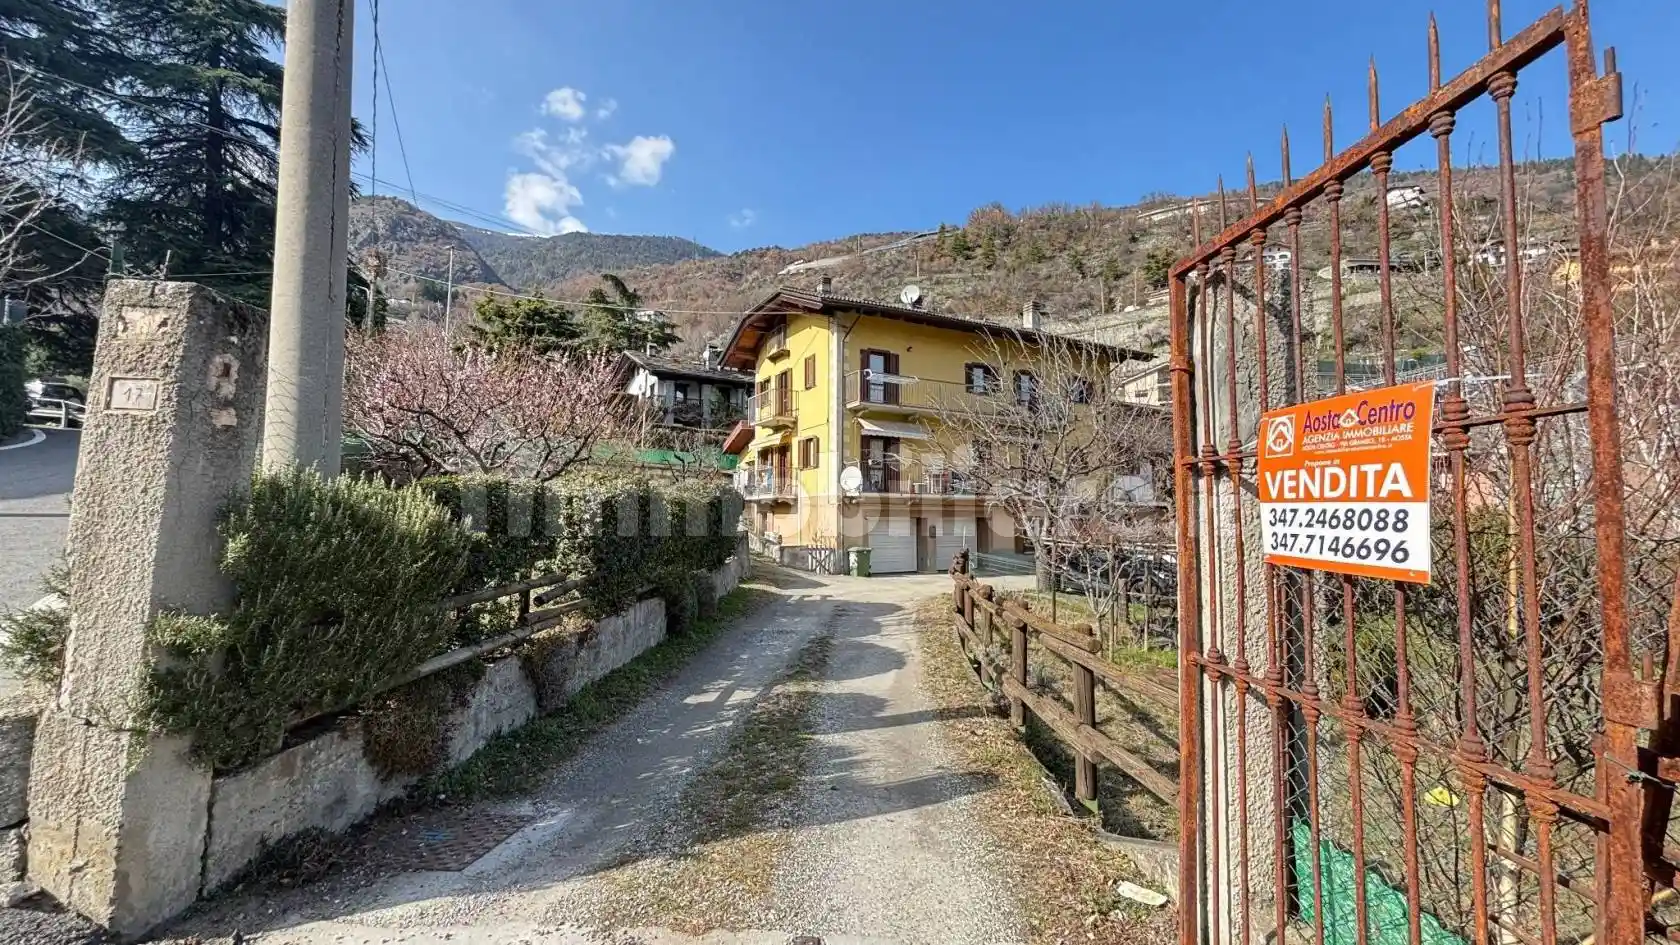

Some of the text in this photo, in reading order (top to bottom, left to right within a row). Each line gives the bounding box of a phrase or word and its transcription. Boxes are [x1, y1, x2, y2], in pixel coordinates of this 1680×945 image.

[1303, 400, 1415, 433] Aosta Centro
[1303, 422, 1415, 445] AGENZIA IMMOBILIARE
[1264, 462, 1414, 500] VENDITA
[1269, 508, 1410, 533] 347.2468088
[1270, 531, 1410, 564] 347.7146696
